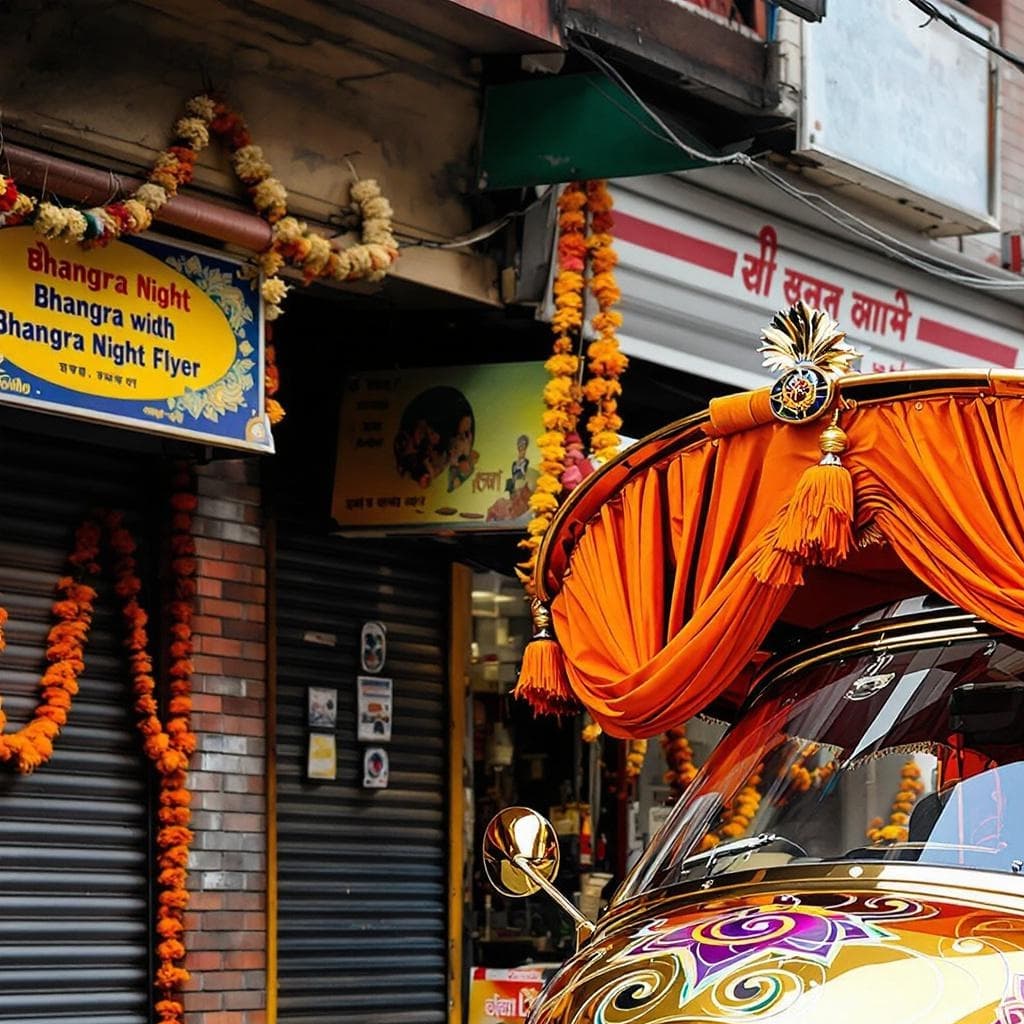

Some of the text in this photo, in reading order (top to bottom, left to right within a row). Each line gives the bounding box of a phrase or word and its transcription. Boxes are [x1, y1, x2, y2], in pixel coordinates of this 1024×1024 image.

[34, 283, 124, 328] Bhangra
[136, 273, 192, 313] Night
[92, 333, 145, 367] Night
[153, 349, 201, 379] Flyer
